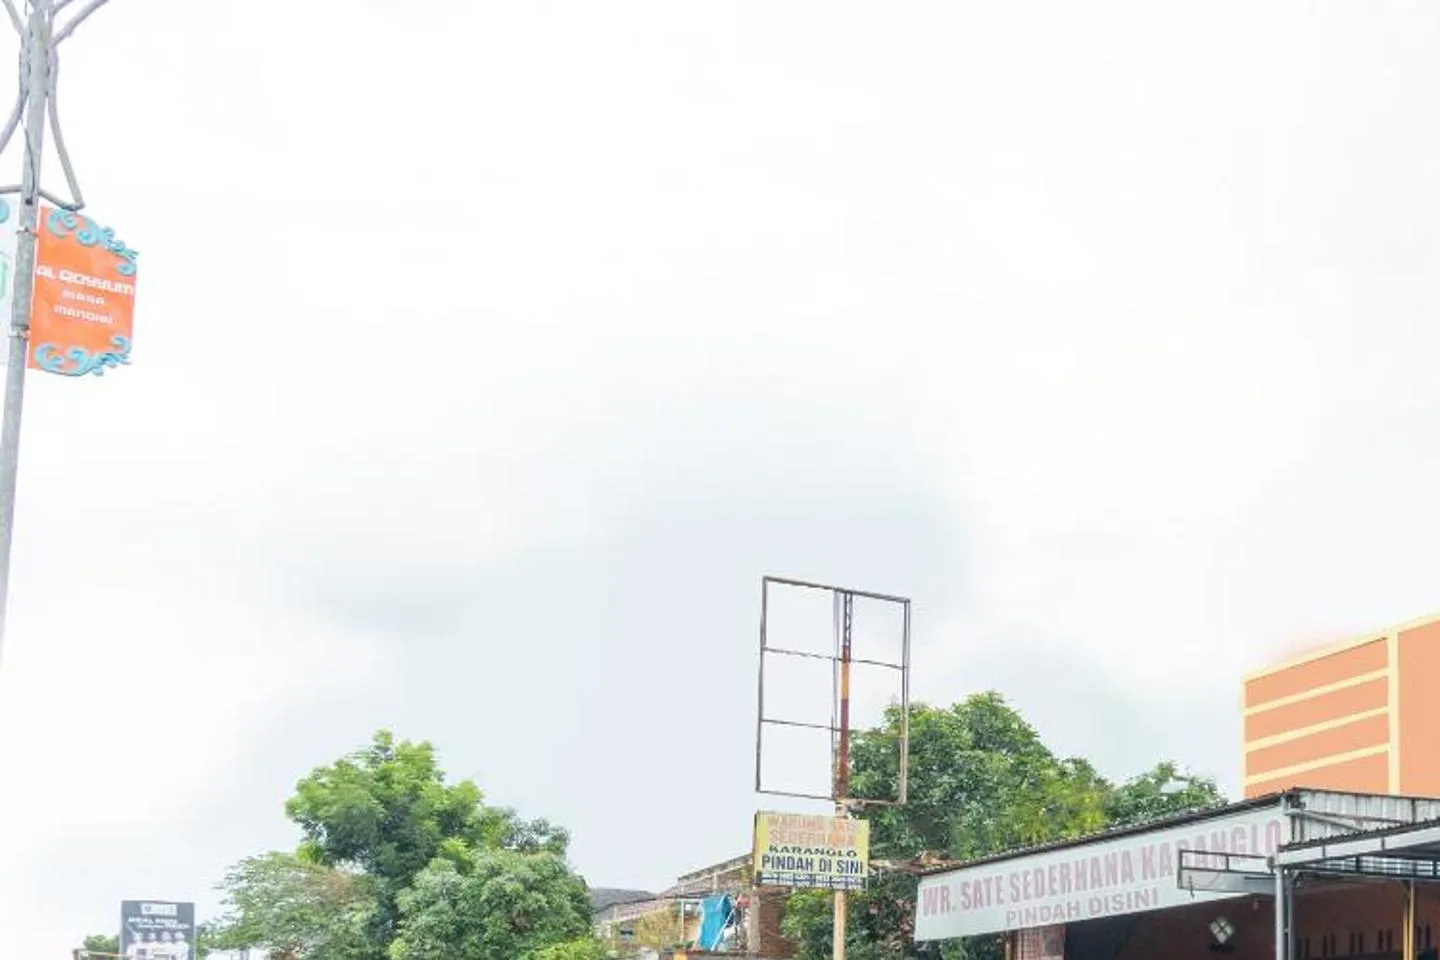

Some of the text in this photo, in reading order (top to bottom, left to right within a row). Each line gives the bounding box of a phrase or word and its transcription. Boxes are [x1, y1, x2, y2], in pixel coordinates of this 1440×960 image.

[762, 853, 863, 875] PINDAH DI SINI
[769, 845, 857, 858] KARANGLO
[961, 873, 1005, 911] SATE
[1009, 850, 1136, 902] SEDERHANA
[1005, 901, 1082, 929] PINDAH
